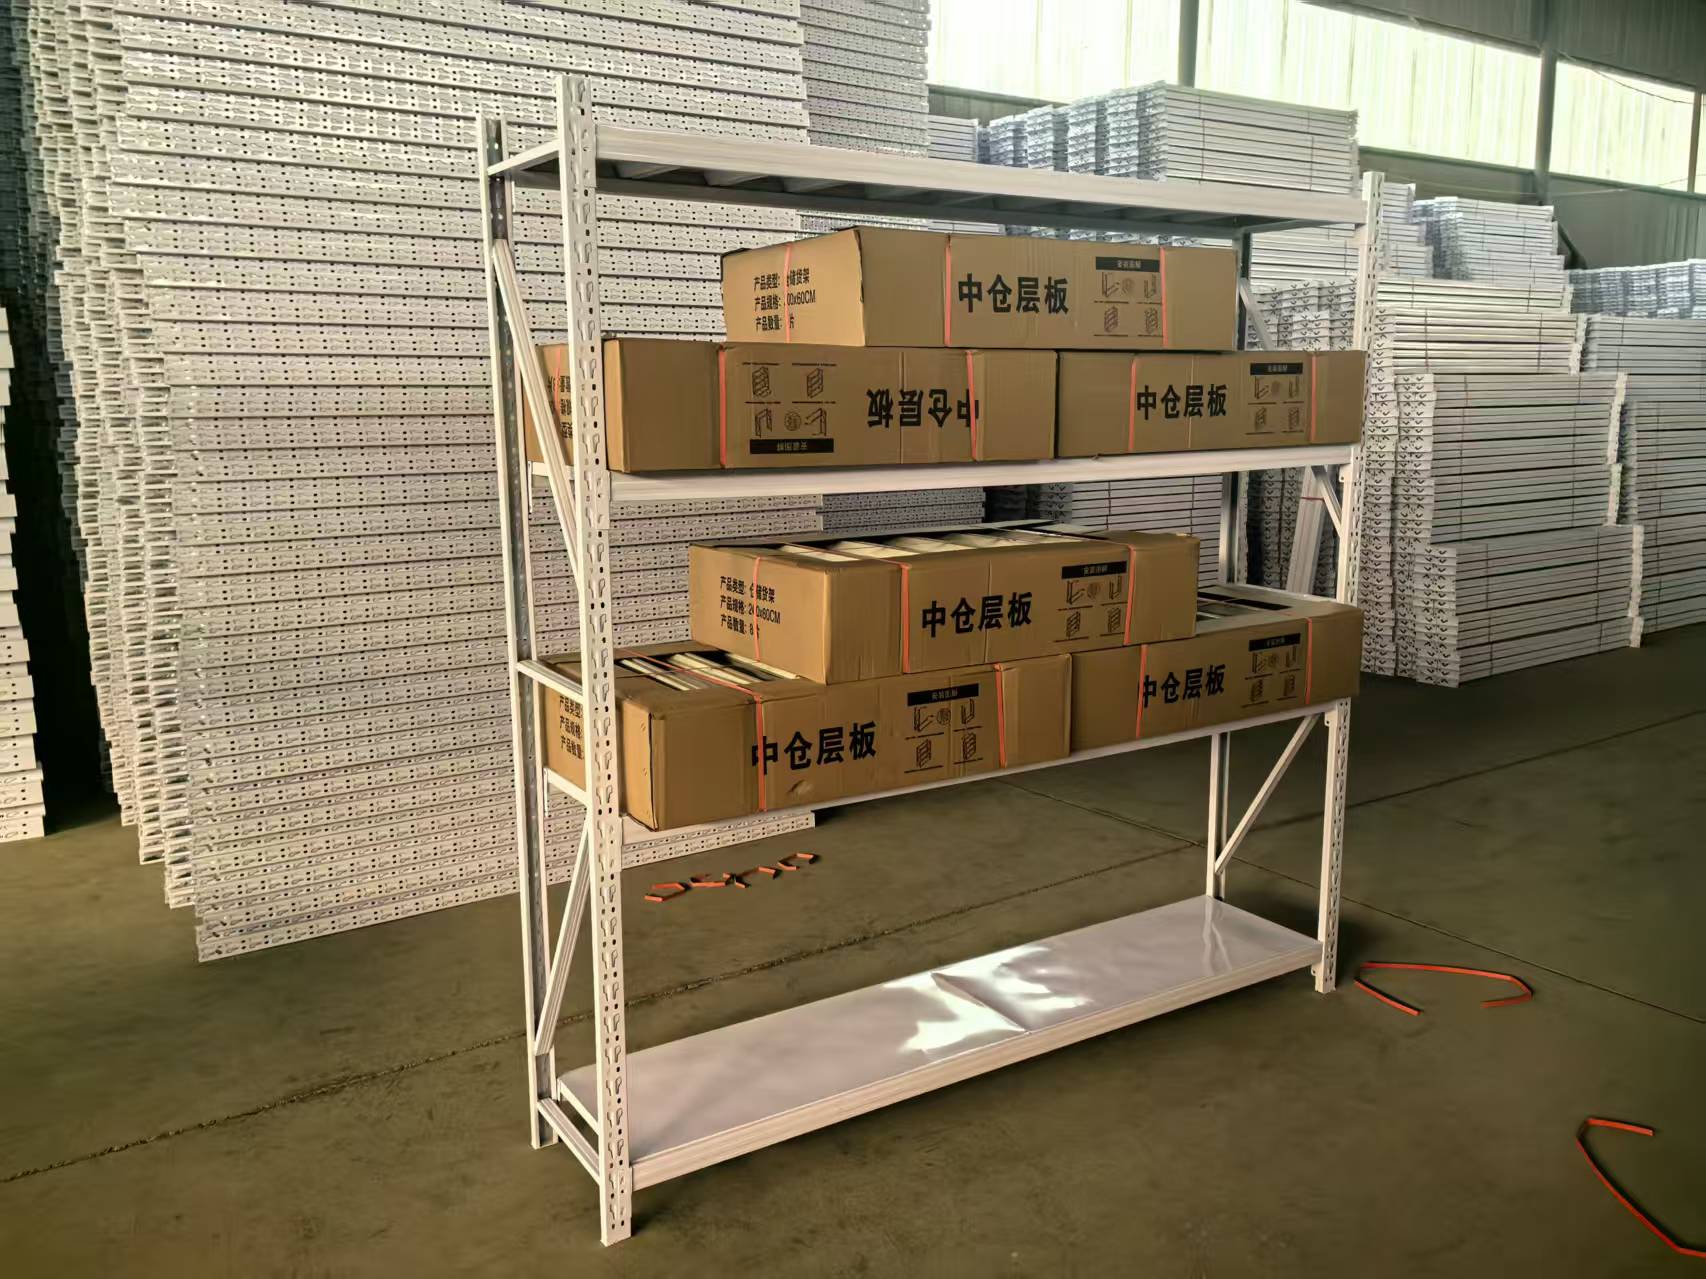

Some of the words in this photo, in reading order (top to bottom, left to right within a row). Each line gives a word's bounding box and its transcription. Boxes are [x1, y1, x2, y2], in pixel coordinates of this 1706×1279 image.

[958, 273, 1069, 314] 中仓层板
[866, 388, 980, 428] 中仓层板
[1136, 384, 1228, 420] 中仓层板
[922, 592, 1033, 638] 中仓层板
[1138, 664, 1226, 708] 中仓层板
[751, 720, 877, 775] 中仓层板
